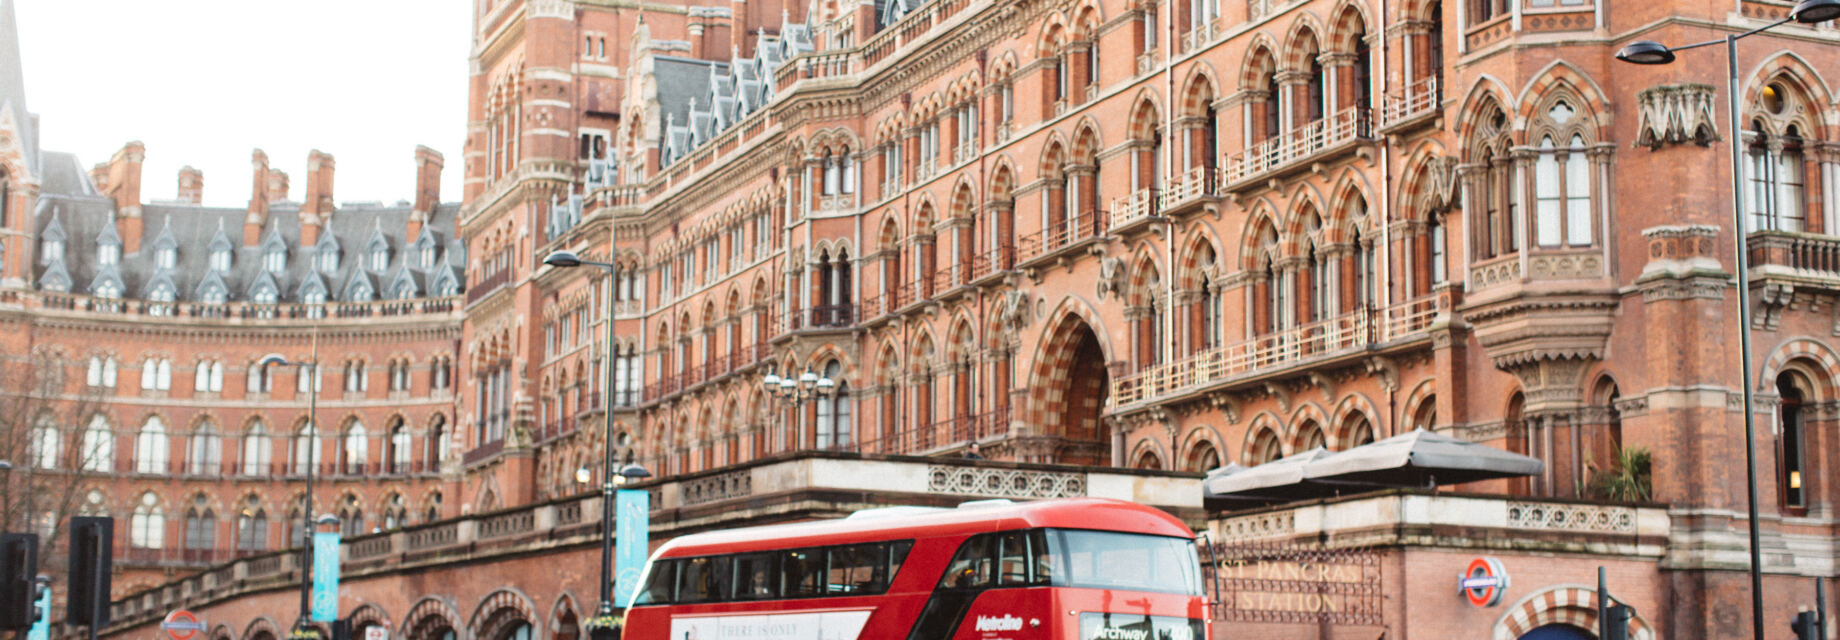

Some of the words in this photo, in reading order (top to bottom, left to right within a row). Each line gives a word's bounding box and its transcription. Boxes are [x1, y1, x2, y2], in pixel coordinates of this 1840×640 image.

[1221, 560, 1247, 578] ST
[1257, 561, 1359, 583] PANCRAS
[1242, 592, 1337, 613] STATION
[1093, 624, 1149, 640] Archway
